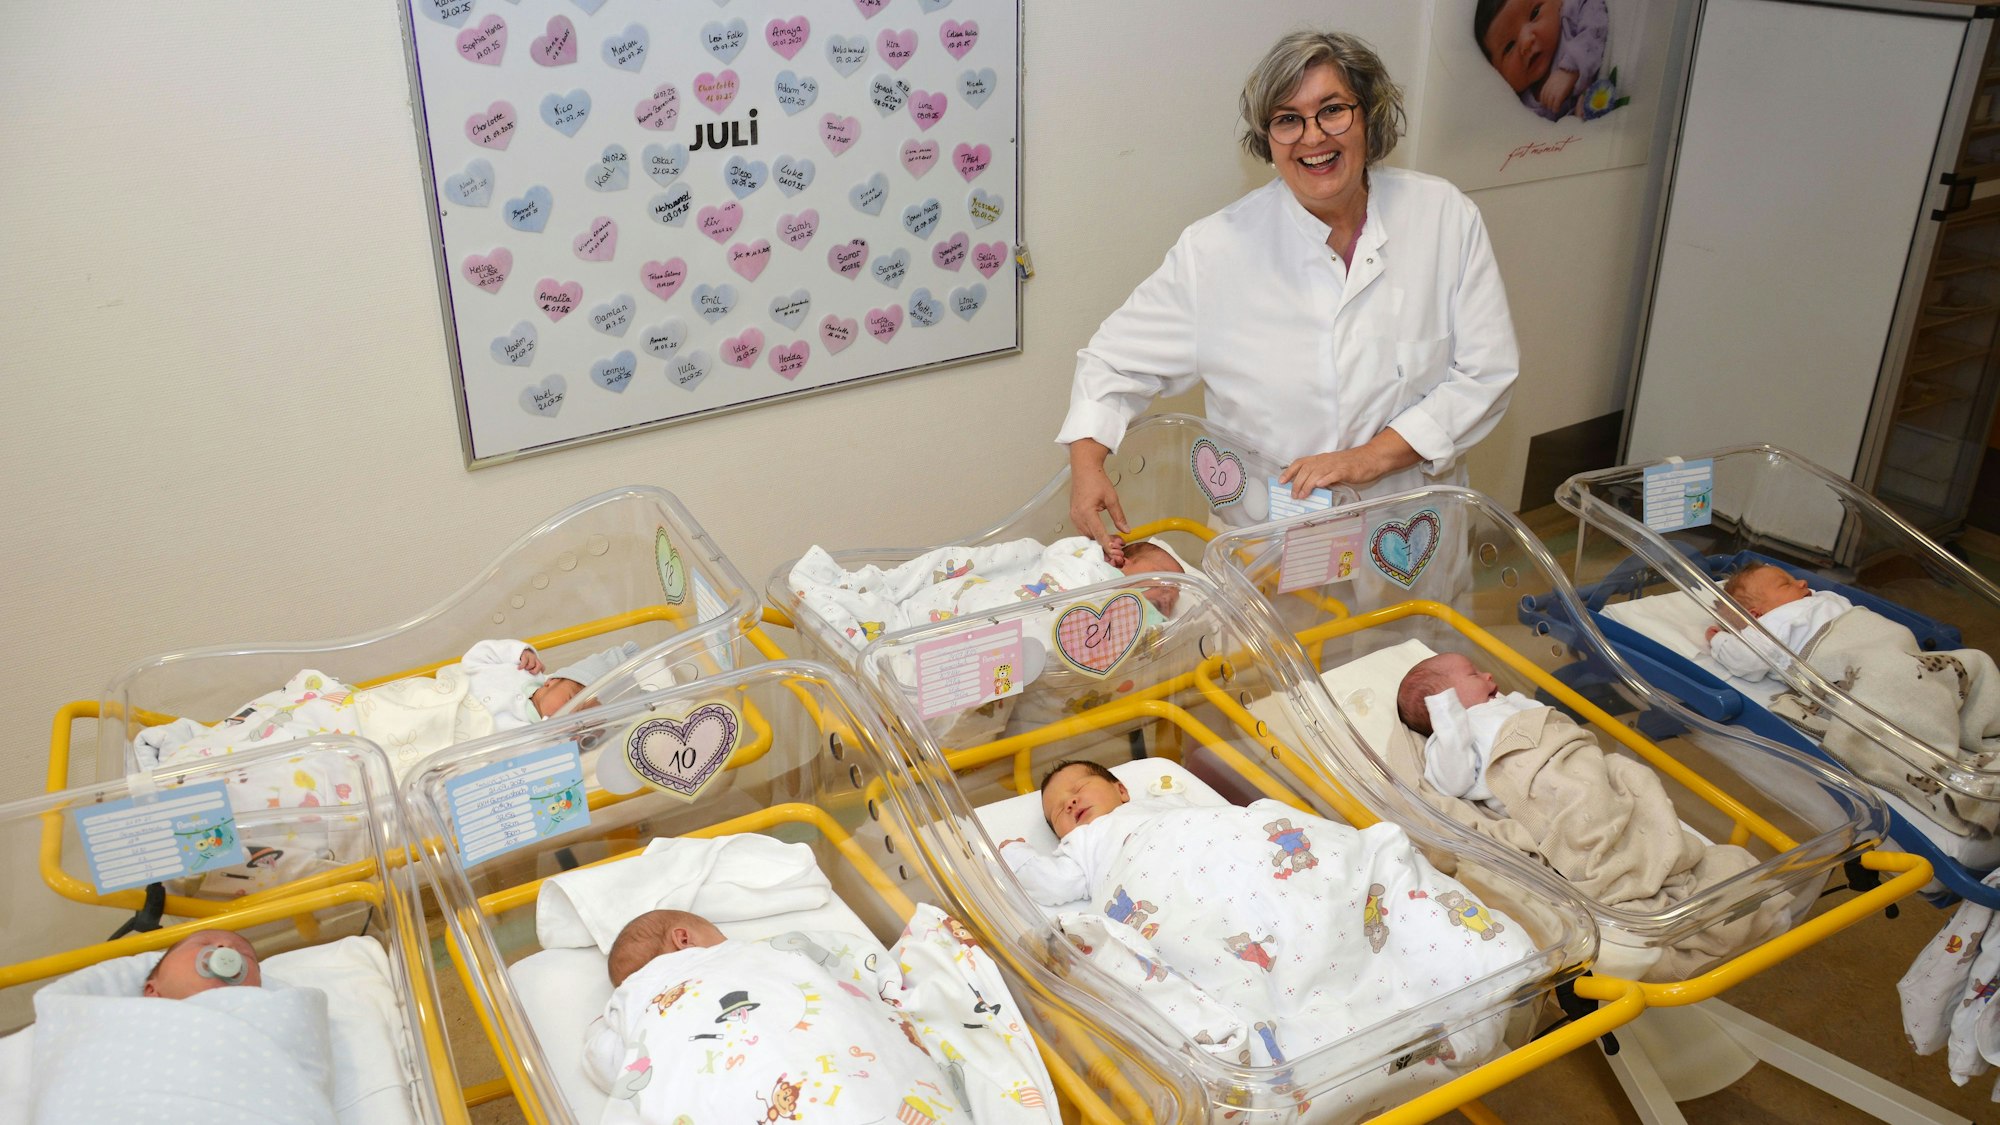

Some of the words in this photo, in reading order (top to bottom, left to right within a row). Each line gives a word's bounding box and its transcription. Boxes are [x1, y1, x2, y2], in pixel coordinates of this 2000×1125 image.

[772, 26, 802, 39] Amaya
[553, 103, 573, 116] Nico
[652, 156, 675, 165] Oskar
[701, 295, 722, 305] Emil
[1209, 466, 1227, 487] 20
[1084, 621, 1112, 649] 21
[668, 747, 697, 774] 10
